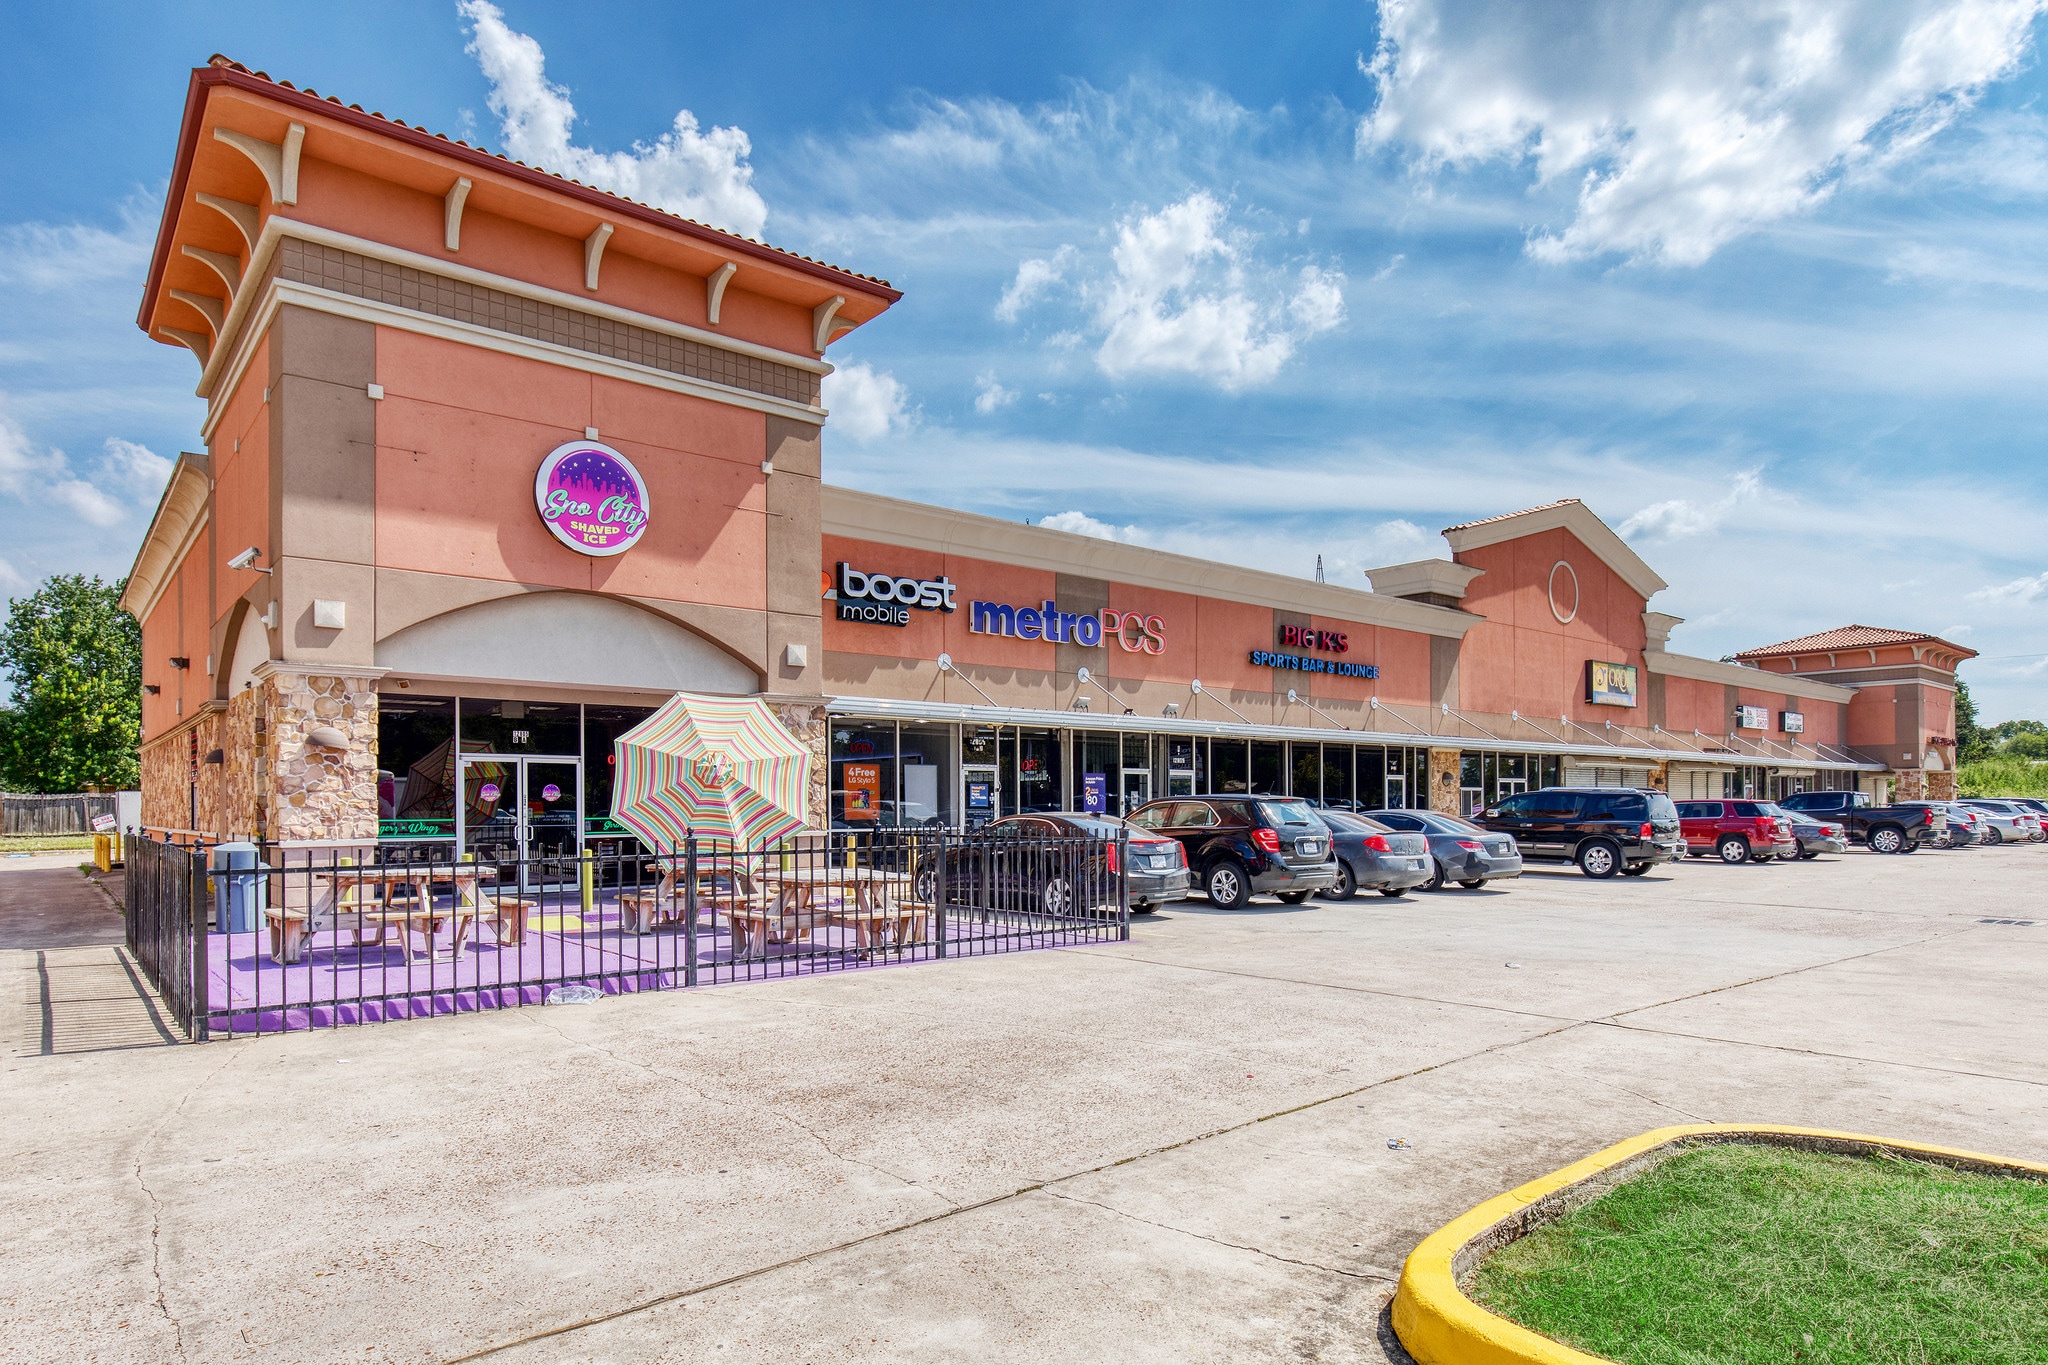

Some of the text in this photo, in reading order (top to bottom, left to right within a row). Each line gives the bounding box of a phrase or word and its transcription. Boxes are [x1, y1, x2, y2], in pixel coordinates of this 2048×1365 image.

[544, 489, 647, 534] Sno City
[570, 520, 620, 535] SHAVED
[583, 533, 608, 544] ICE
[842, 561, 957, 609] boost
[842, 604, 910, 624] mobile
[970, 600, 1167, 655] metroPCS
[1283, 625, 1349, 653] BIG K'S
[1252, 650, 1380, 679] SPORTS BAR & LOUNGE
[849, 742, 874, 754] OPEN
[848, 768, 876, 777] 4 Free
[857, 777, 871, 786] Stylo
[1085, 786, 1091, 797] 2
[379, 821, 440, 835] gerz Wingz
